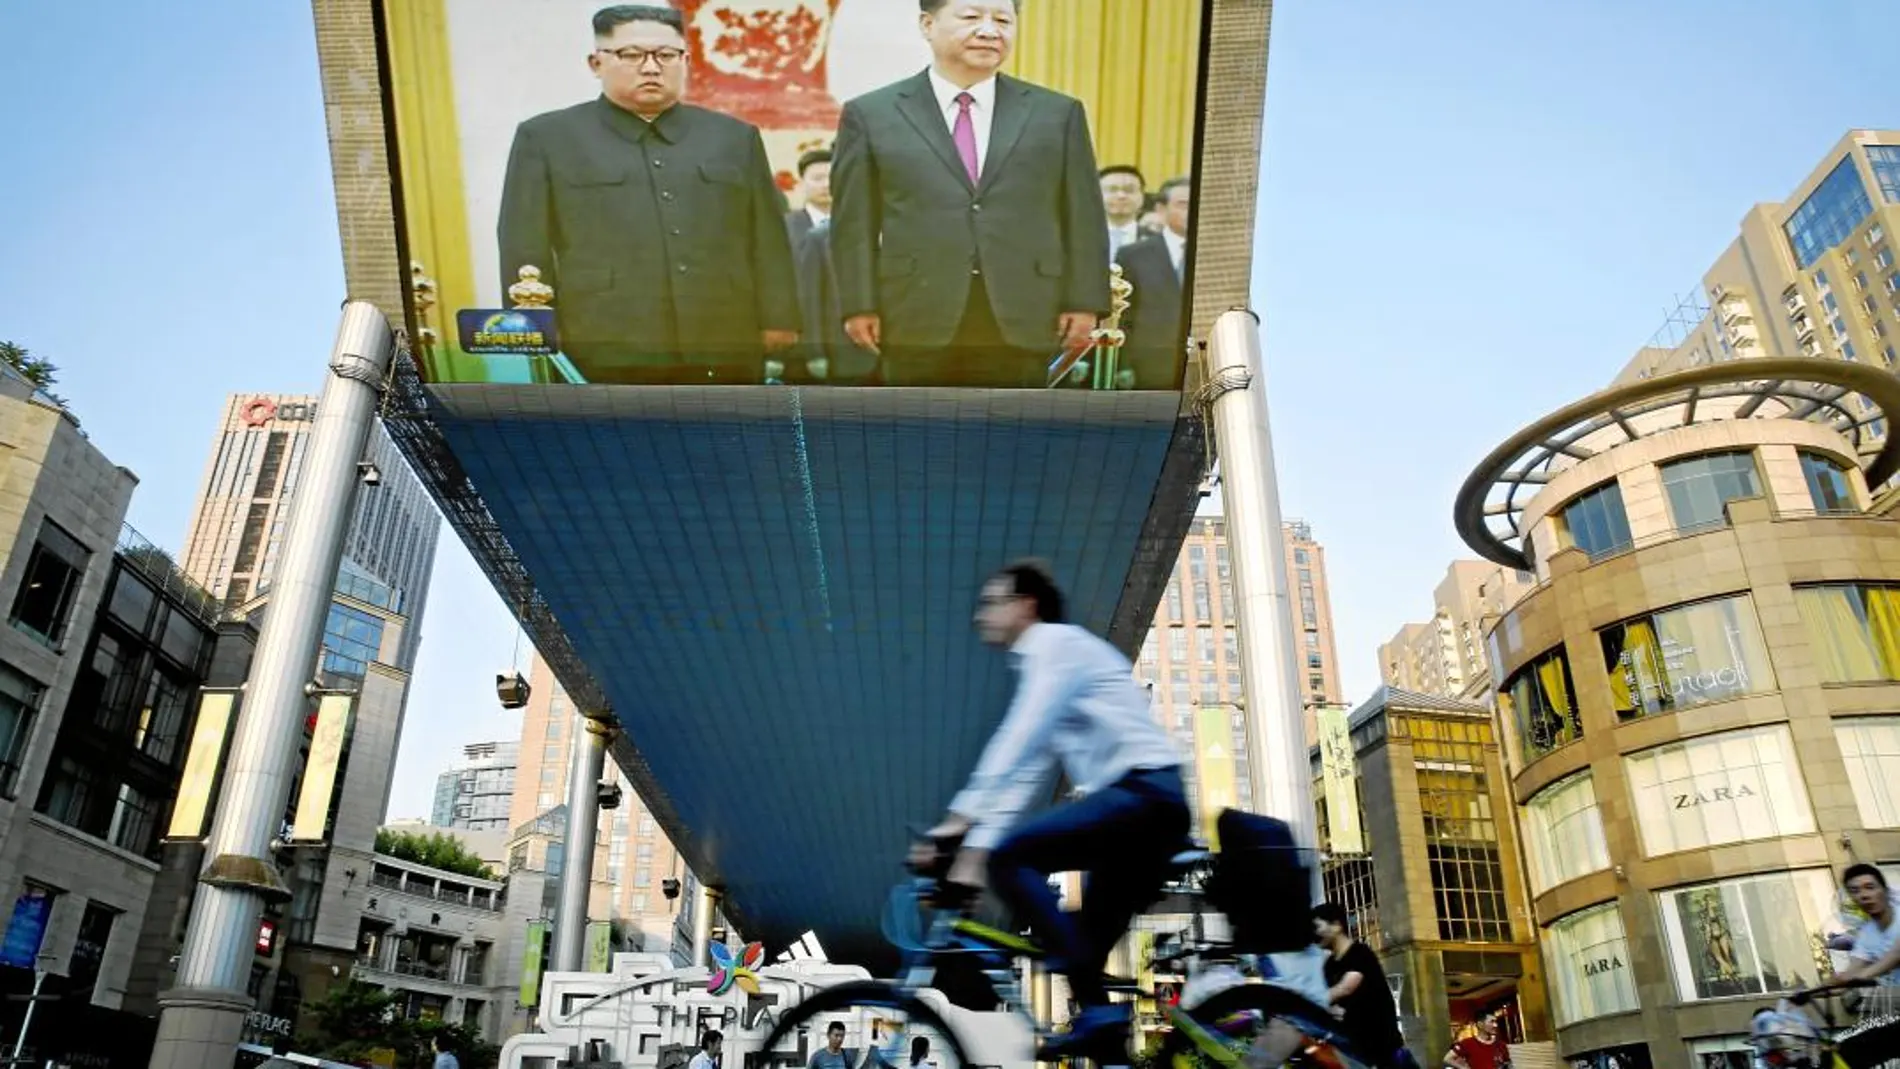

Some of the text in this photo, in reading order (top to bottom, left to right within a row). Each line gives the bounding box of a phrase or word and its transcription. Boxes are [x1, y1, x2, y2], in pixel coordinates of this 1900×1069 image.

[1674, 784, 1755, 809] ZARA
[261, 1013, 292, 1036] PLACE
[651, 1004, 811, 1030] THE PLAC
